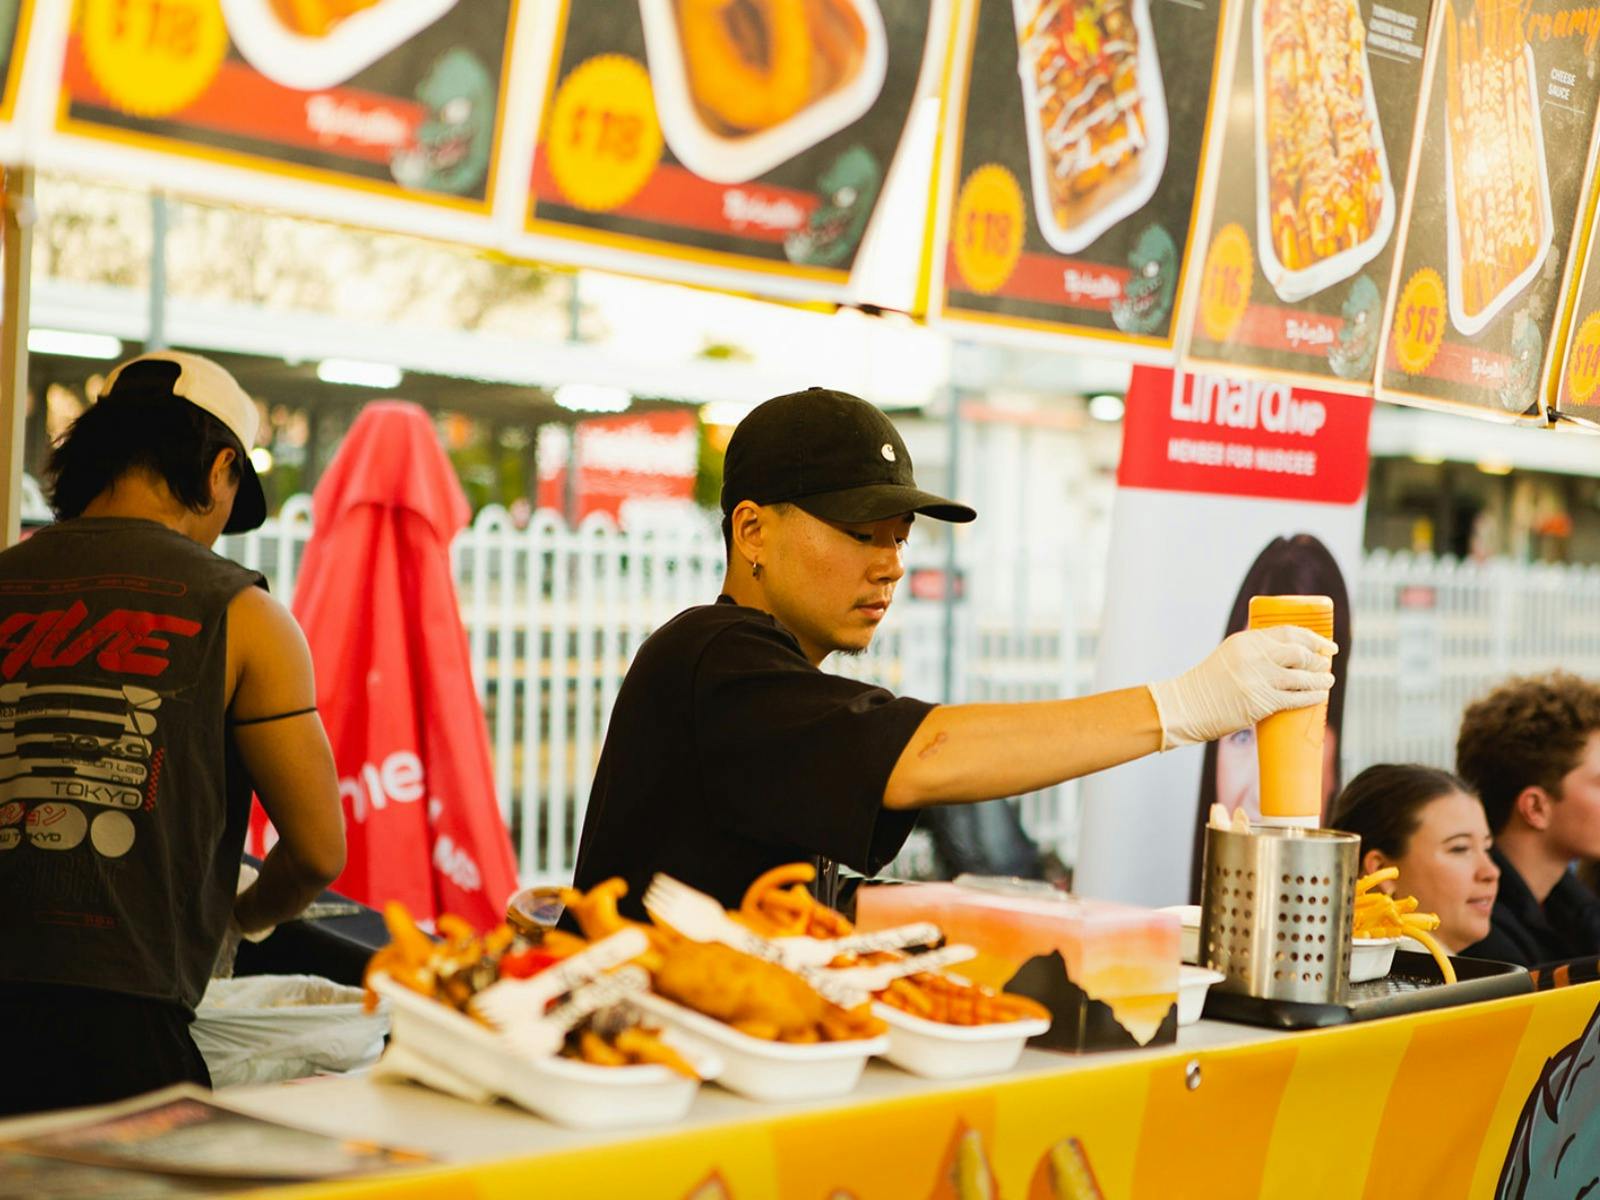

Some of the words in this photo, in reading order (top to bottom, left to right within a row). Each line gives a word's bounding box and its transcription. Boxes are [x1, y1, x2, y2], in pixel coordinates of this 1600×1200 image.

[1551, 67, 1577, 87] CHEESE
[1547, 83, 1571, 101] SAUCE
[1402, 303, 1438, 344] $15
[1225, 443, 1254, 470] FOR
[50, 780, 140, 807] TOKYO
